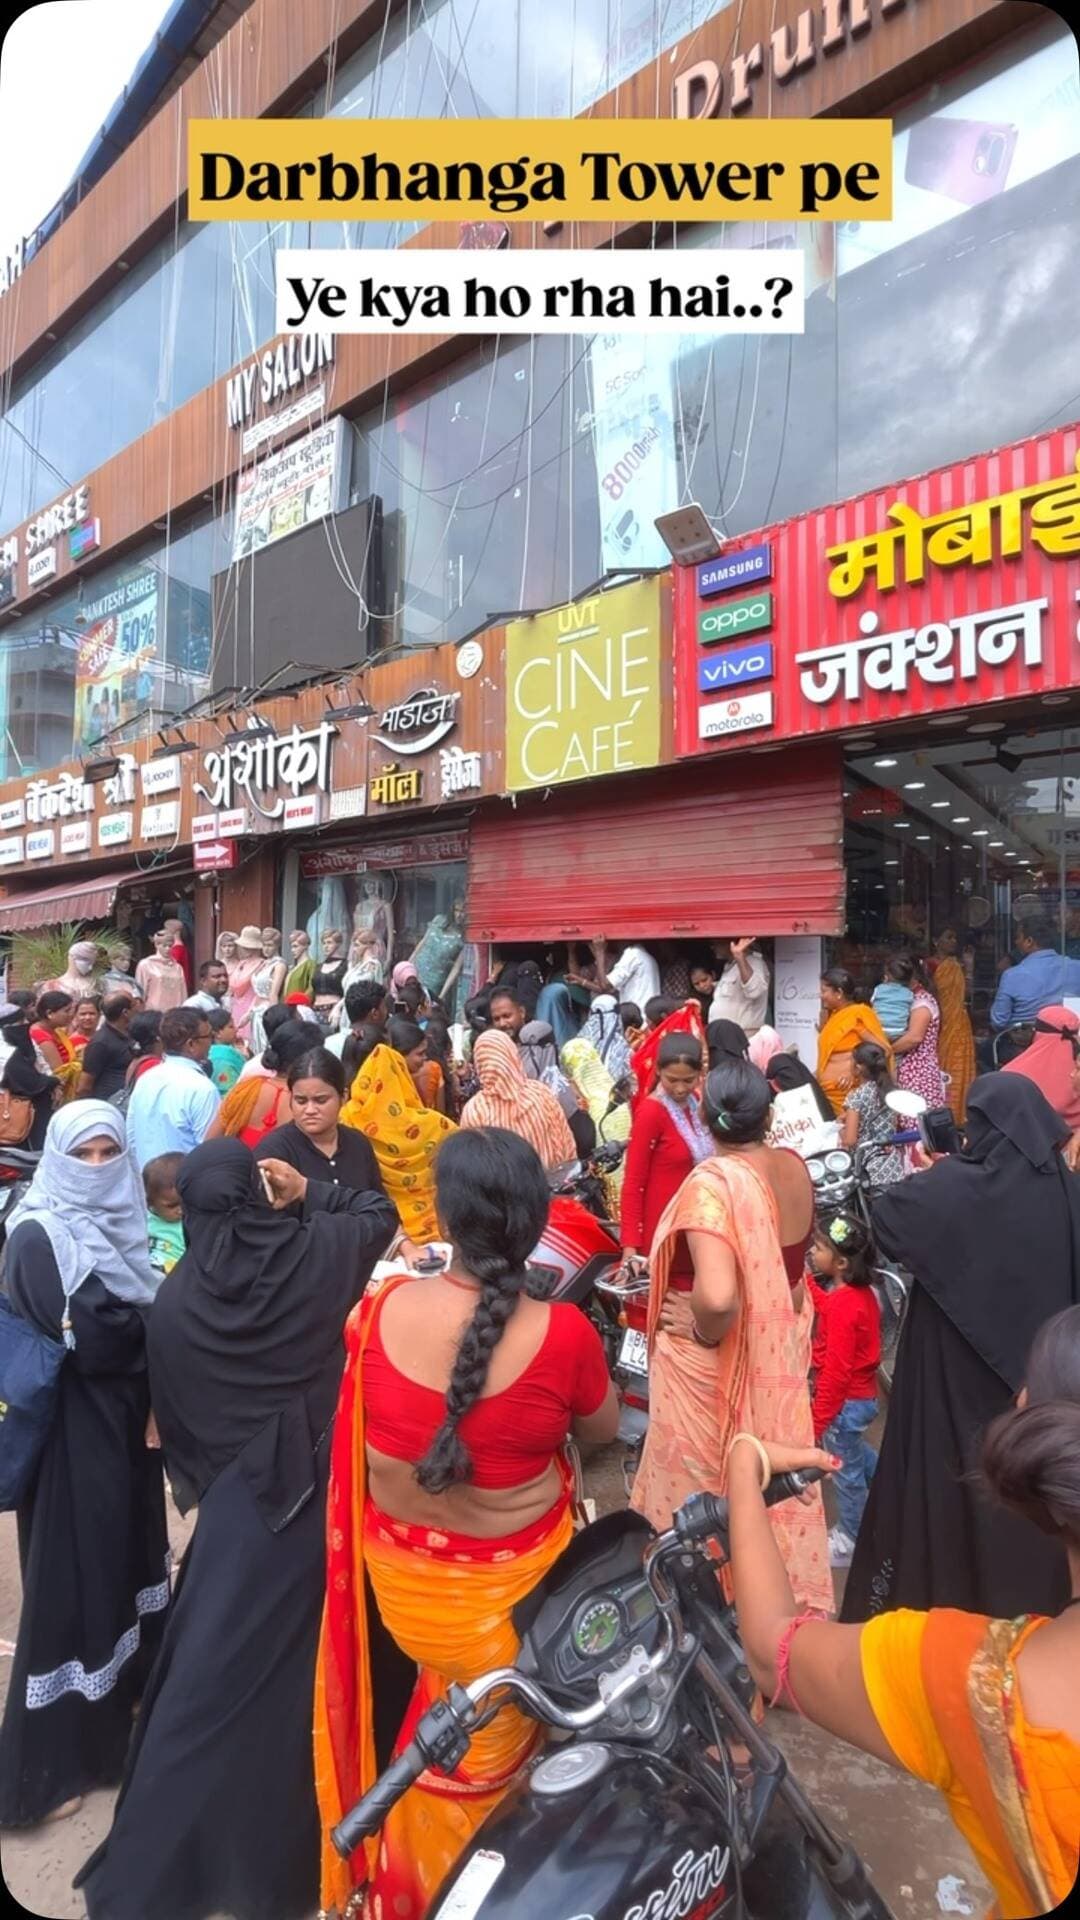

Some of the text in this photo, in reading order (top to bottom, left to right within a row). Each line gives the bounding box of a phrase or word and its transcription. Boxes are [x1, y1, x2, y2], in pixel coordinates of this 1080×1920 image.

[227, 362, 257, 429] MY
[260, 333, 334, 403] SALON
[25, 484, 88, 556] SHREE
[126, 571, 157, 603] SHREE
[701, 557, 764, 586] SAMSUNG
[122, 609, 156, 652] 50%
[558, 600, 599, 633] UVT
[702, 602, 767, 633] oppo
[703, 655, 765, 682] vivo
[795, 597, 1049, 704] जंक्शन
[513, 628, 650, 720] CINE
[705, 711, 765, 733] motorola
[371, 763, 418, 804] मॉल
